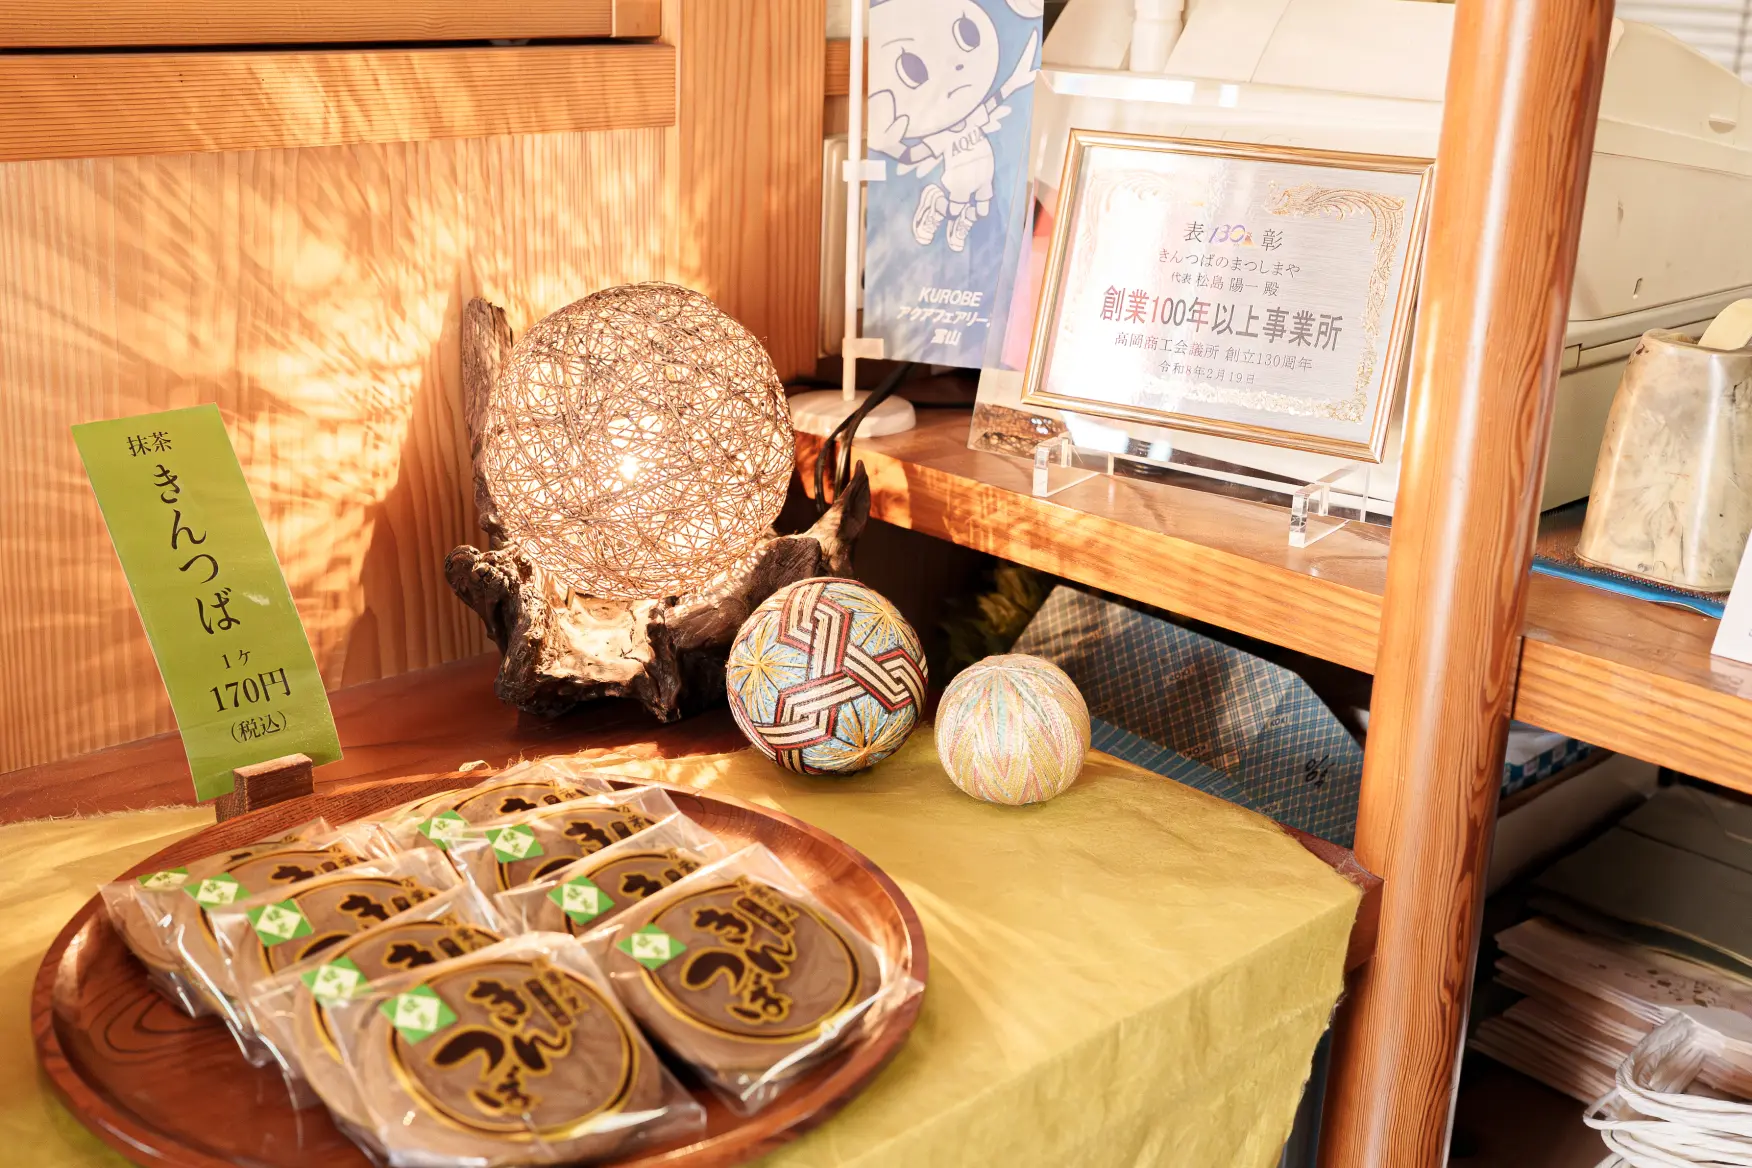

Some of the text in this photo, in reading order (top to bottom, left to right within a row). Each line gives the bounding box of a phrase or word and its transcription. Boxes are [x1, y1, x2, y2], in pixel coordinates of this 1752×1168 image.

[1184, 221, 1204, 243] 表
[1261, 228, 1283, 252] 彰
[1158, 248, 1301, 279] きんつばのまつしまや
[918, 286, 984, 307] KUROBE
[1263, 281, 1280, 297] 殿
[1099, 284, 1344, 352] 創業100年以上事業所
[127, 431, 172, 457] 抹茶
[153, 464, 241, 635] きんつば
[210, 667, 291, 712] 170円
